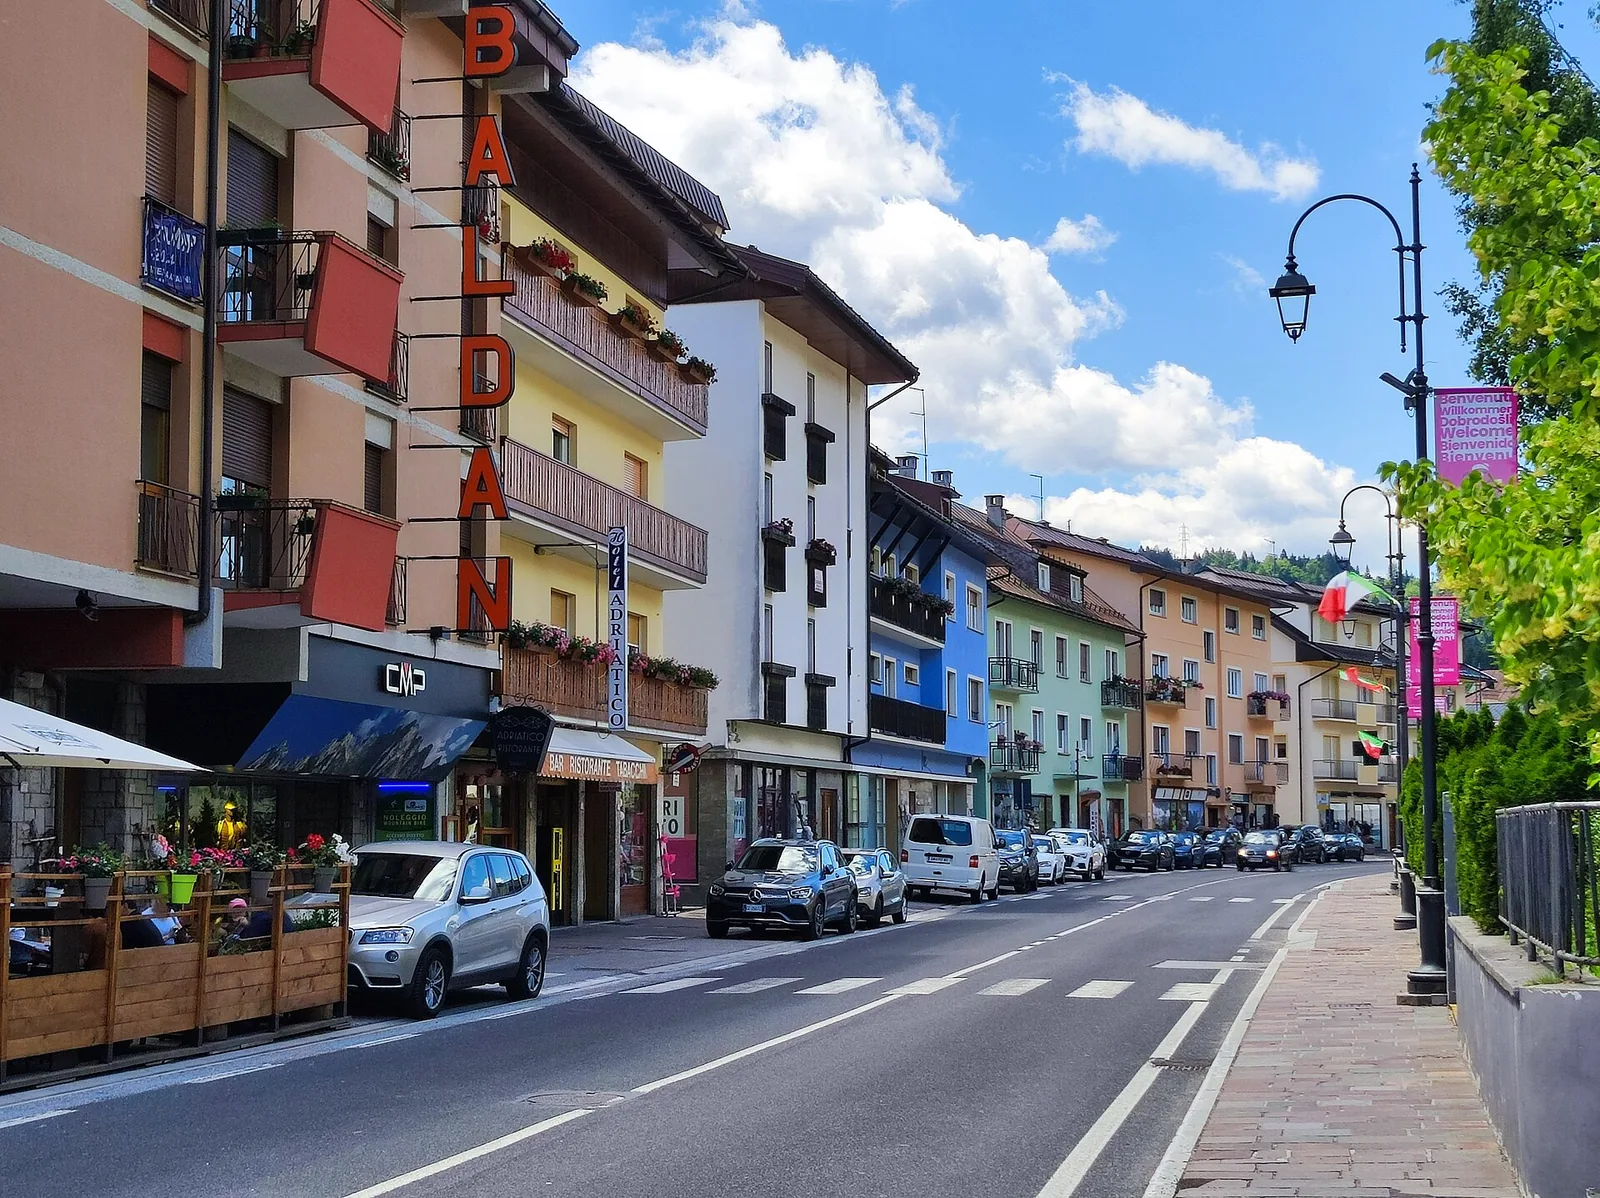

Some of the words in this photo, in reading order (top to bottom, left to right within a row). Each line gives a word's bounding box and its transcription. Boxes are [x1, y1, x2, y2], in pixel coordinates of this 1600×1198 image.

[457, 5, 518, 632] BALDAN
[1441, 426, 1512, 439] Welcome
[609, 527, 625, 588] Hotel
[610, 593, 624, 727] ADRIATICO
[386, 662, 426, 697] CMP
[496, 731, 544, 742] ADRIATICO
[497, 744, 541, 754] RISTORANTE
[549, 753, 564, 772] BAR
[569, 756, 611, 777] RISTORANTE
[615, 761, 648, 779] TABACCHI
